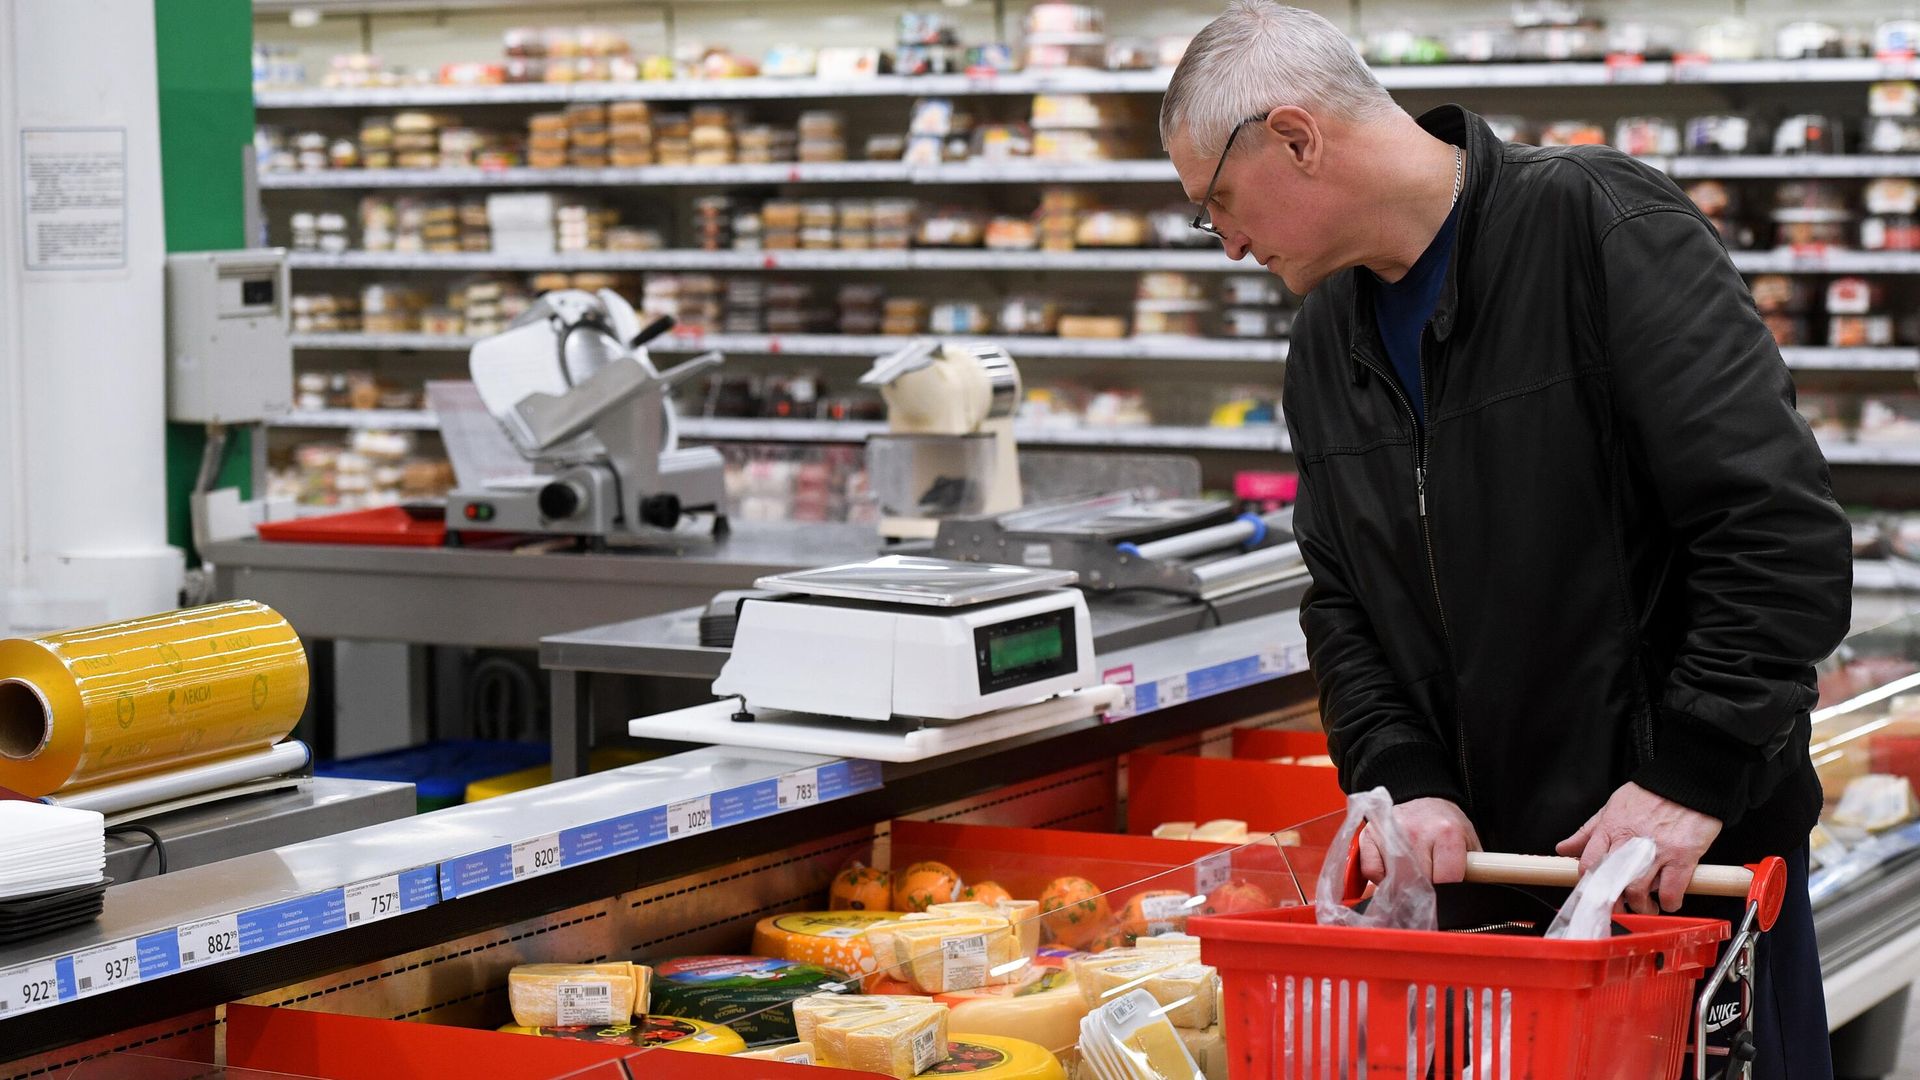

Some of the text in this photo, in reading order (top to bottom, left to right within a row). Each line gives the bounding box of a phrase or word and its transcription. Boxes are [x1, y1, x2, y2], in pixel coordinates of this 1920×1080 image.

[183, 685, 211, 705] ЛЕКСИ
[796, 783, 812, 800] 783
[687, 809, 706, 828] 1029
[534, 848, 554, 867] 820
[371, 893, 391, 914] 757
[207, 932, 231, 953] 882
[105, 957, 128, 981] 937
[22, 980, 49, 1004] 922
[1708, 1002, 1740, 1022] NIKE
